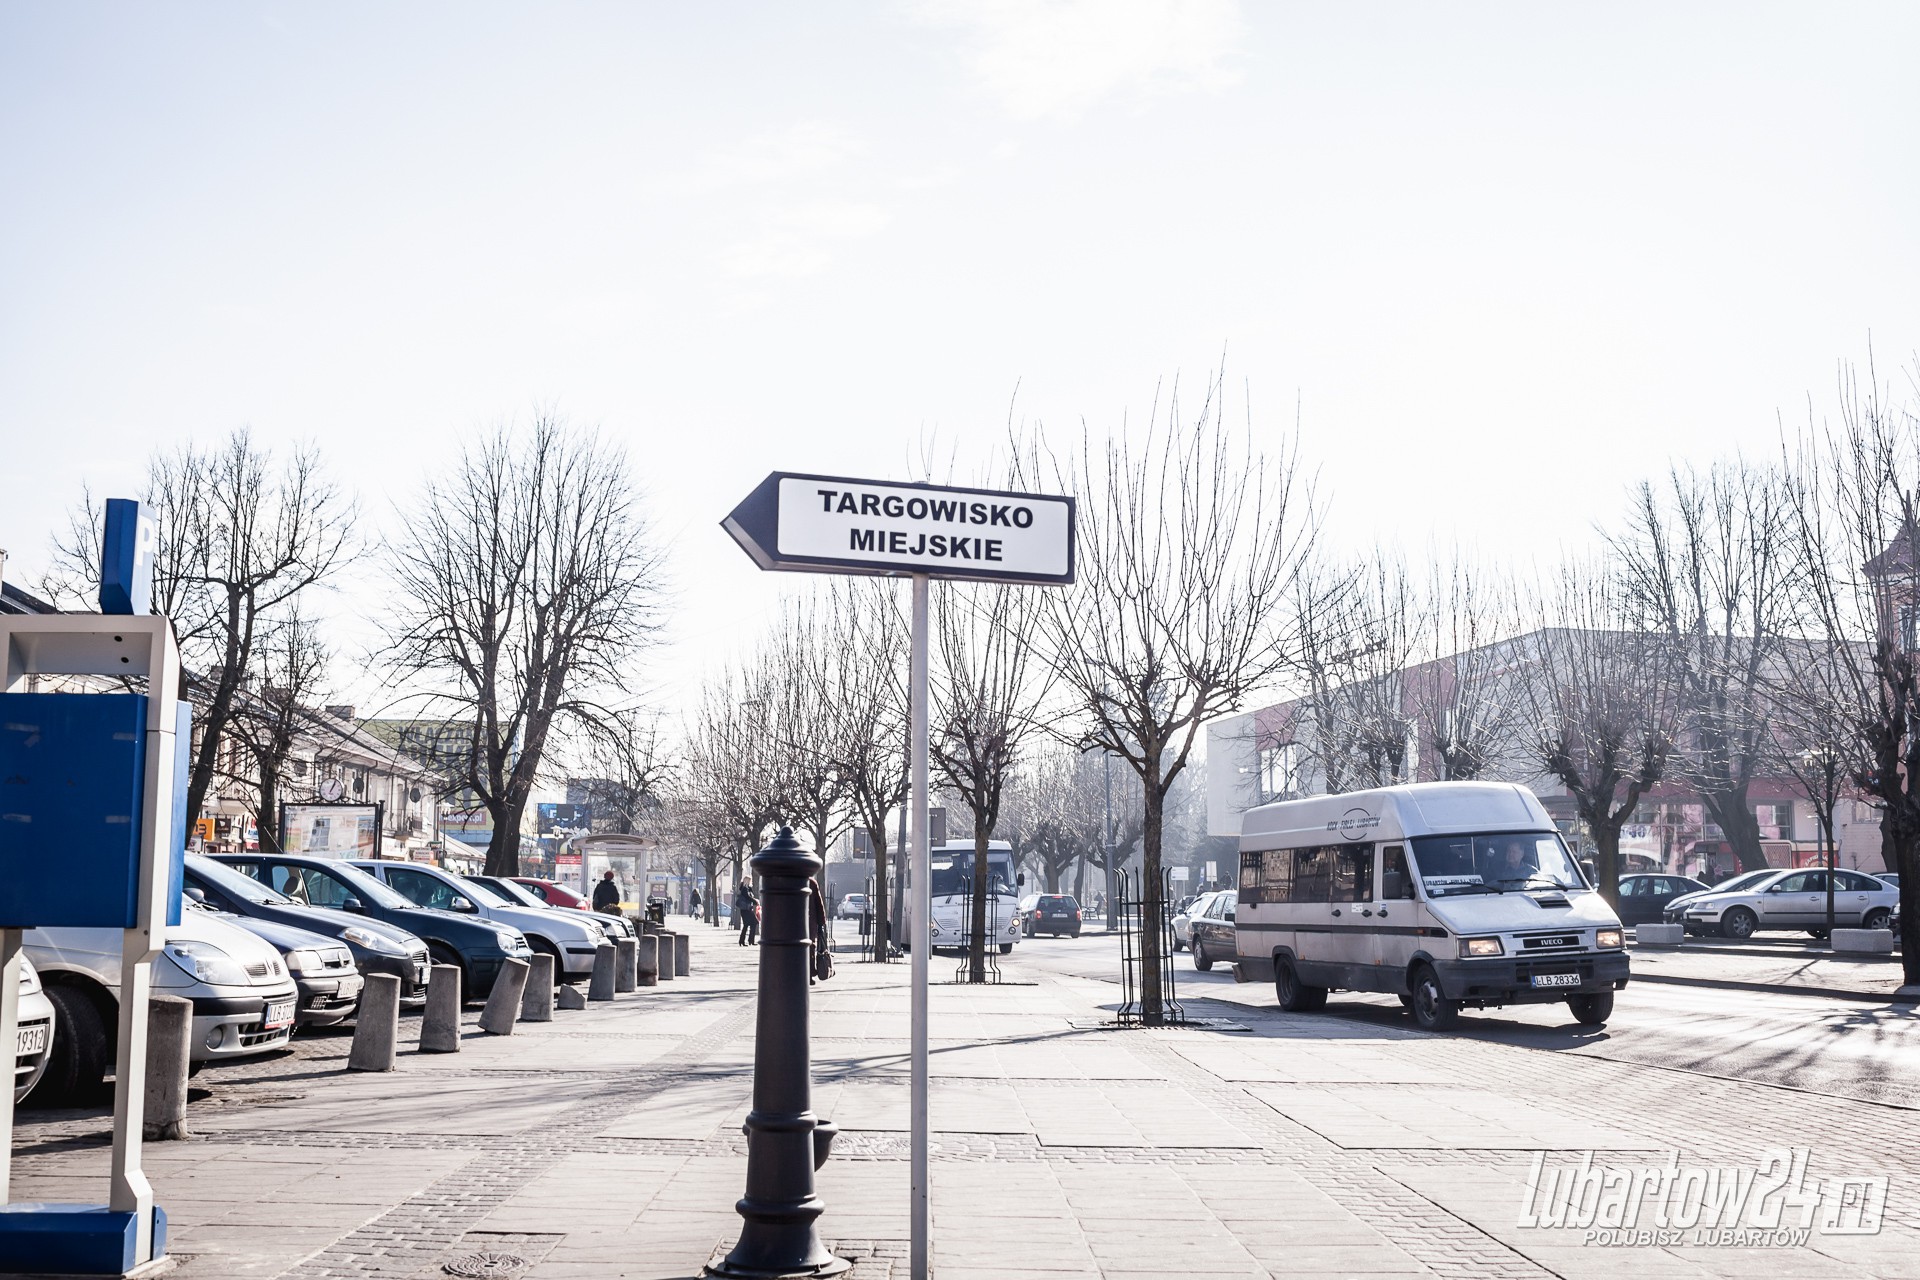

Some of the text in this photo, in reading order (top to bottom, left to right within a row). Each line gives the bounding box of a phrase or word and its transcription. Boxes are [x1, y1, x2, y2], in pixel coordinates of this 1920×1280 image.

[818, 490, 1033, 528] TARGOWISKO
[136, 514, 155, 567] P
[850, 528, 1003, 561] MIEJSKIE
[1540, 938, 1563, 946] IVECO
[1554, 975, 1580, 985] 28336
[17, 1029, 44, 1053] 19312
